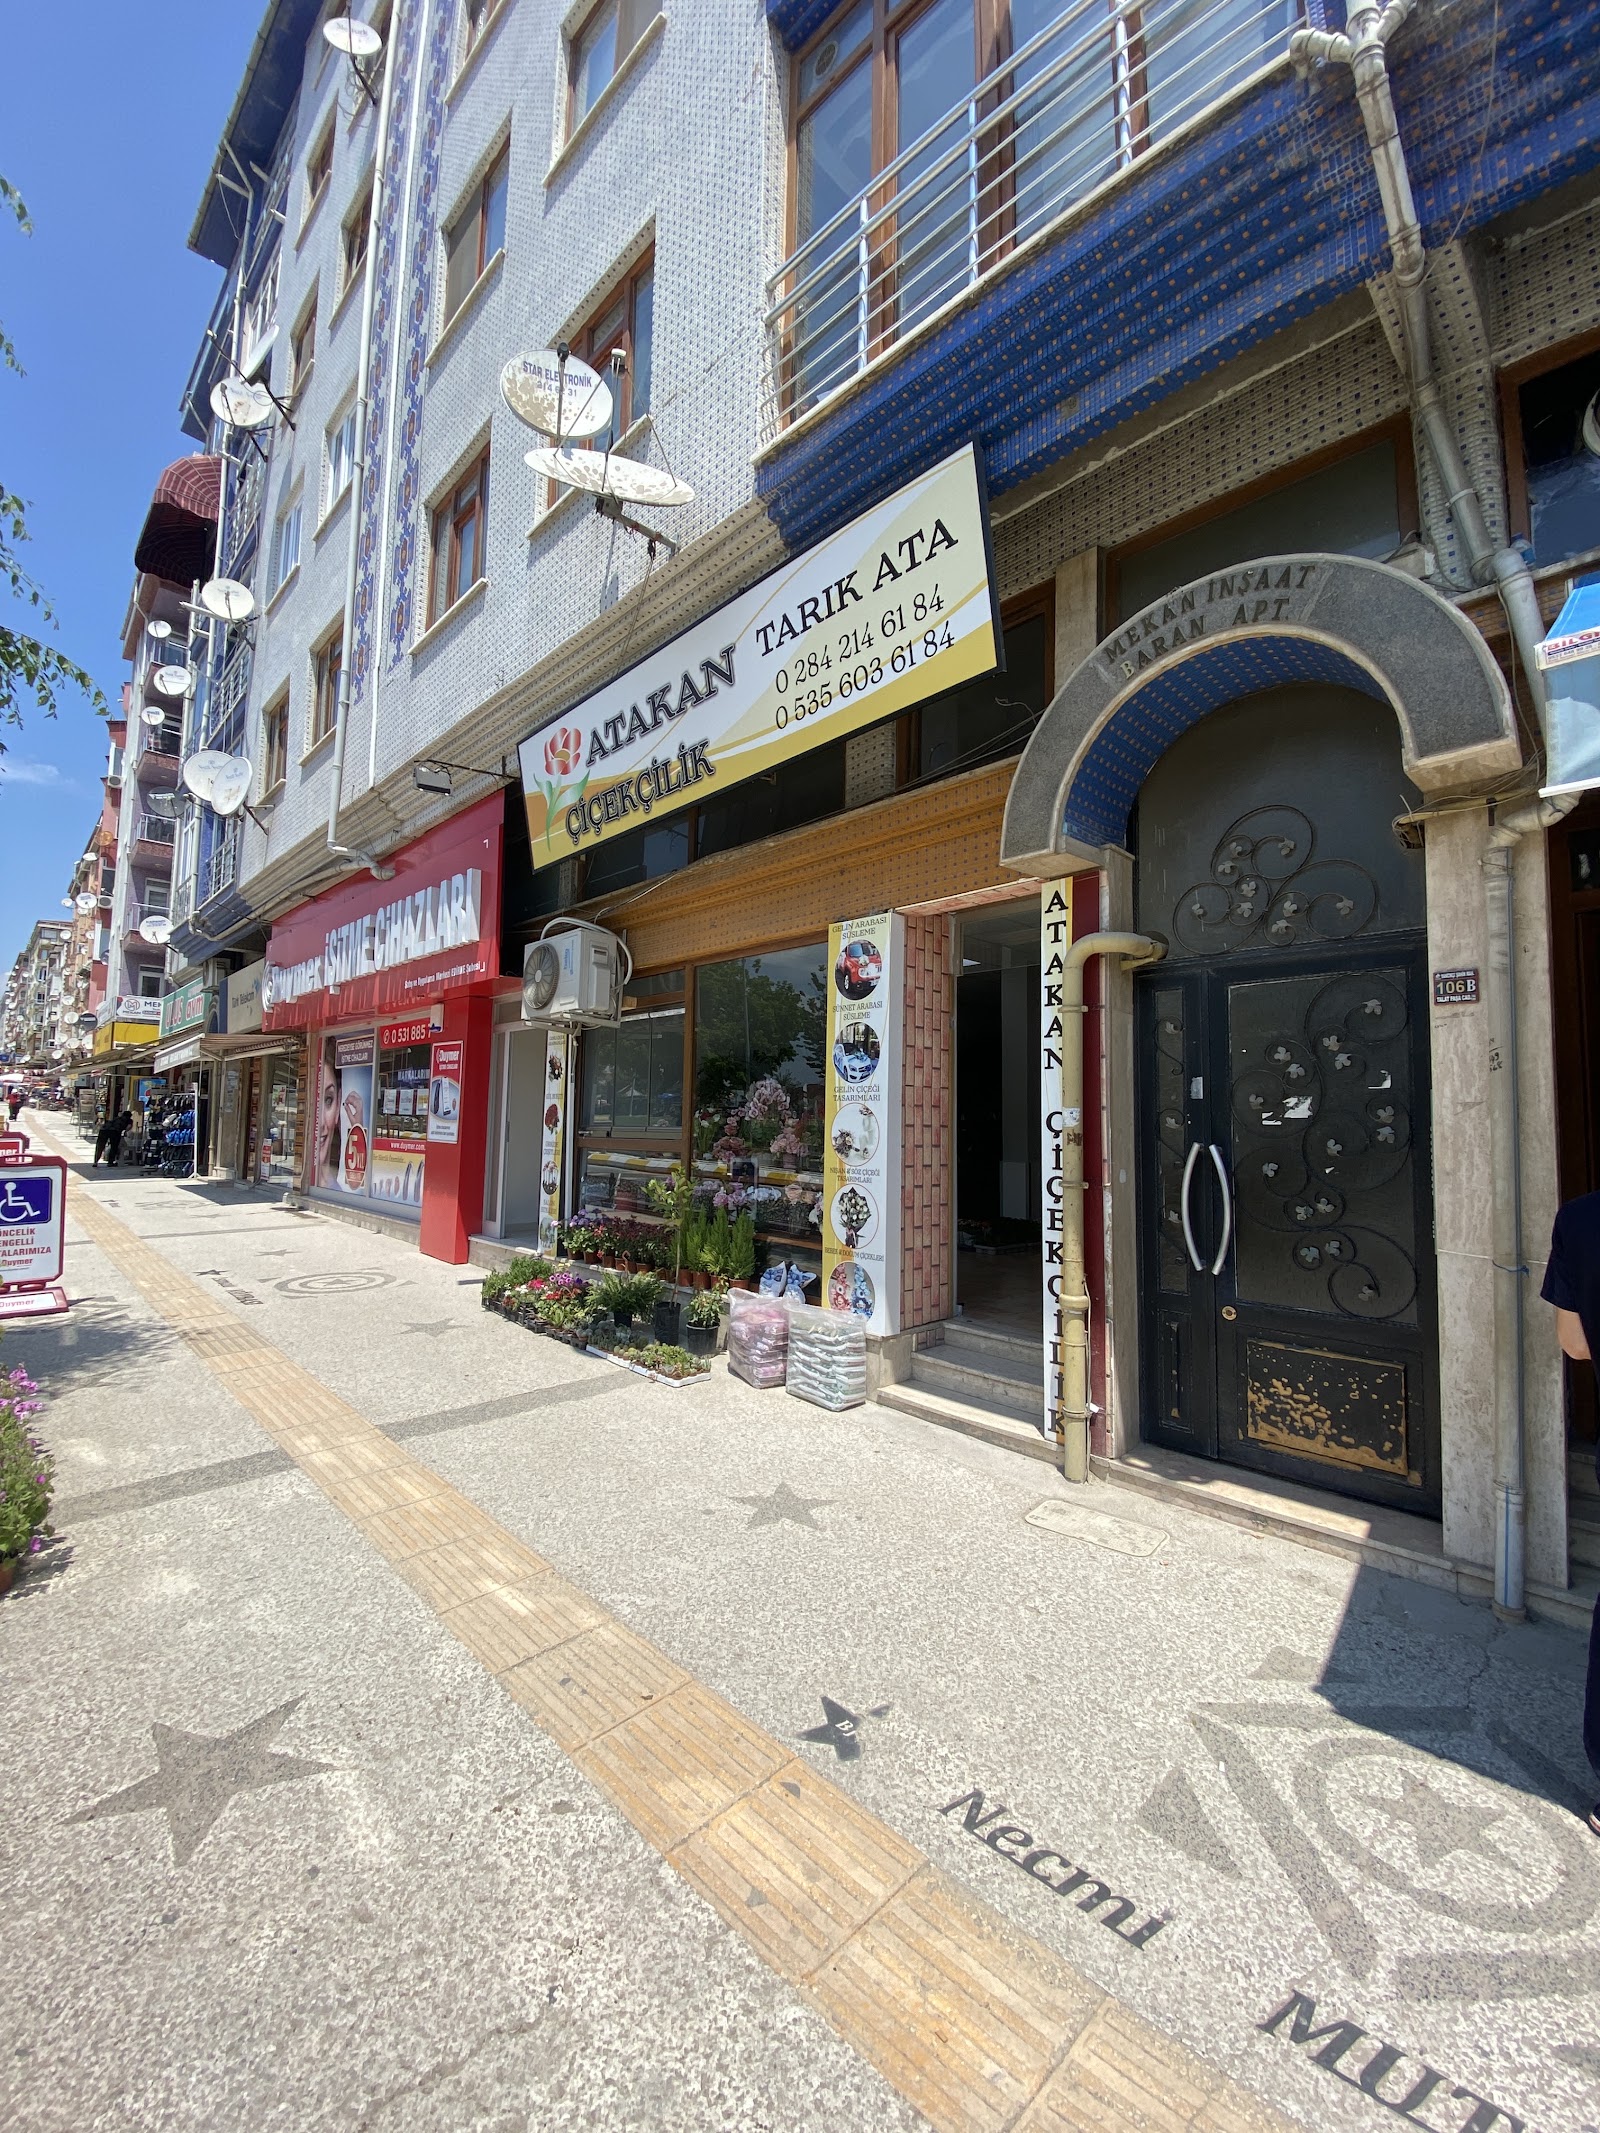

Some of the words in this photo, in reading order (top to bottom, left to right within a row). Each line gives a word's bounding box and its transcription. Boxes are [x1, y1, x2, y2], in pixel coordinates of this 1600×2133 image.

[522, 360, 543, 377] STAR
[544, 368, 592, 388] ELETRONİK
[755, 570, 863, 656] TARIK
[872, 518, 959, 592] ATA
[775, 669, 789, 694] 0
[794, 644, 833, 686] 284
[838, 621, 875, 663] 214
[880, 603, 907, 638] 61
[913, 583, 945, 622] 84
[1103, 590, 1196, 665] MEKAN
[1119, 614, 1206, 680] BARAN
[775, 705, 789, 730] 0
[794, 681, 833, 721] 535
[839, 656, 883, 698] 603
[890, 639, 917, 674] 61
[923, 620, 955, 658] 84
[585, 642, 736, 767] ATAKAN
[565, 737, 716, 845] ÇİÇEKÇİLİK
[842, 927, 876, 940] SÜSLEME
[854, 917, 887, 929] ARABASI
[1044, 890, 1069, 1070] ATAKAN
[843, 1011, 871, 1021] SÜSLEME
[857, 1001, 883, 1011] ARABASI
[398, 1027, 410, 1042] 531
[411, 1024, 426, 1040] 885
[833, 1094, 881, 1102] TASARIMLARI
[348, 1135, 357, 1170] 5
[0, 1246, 51, 1258] ALARIMIZA
